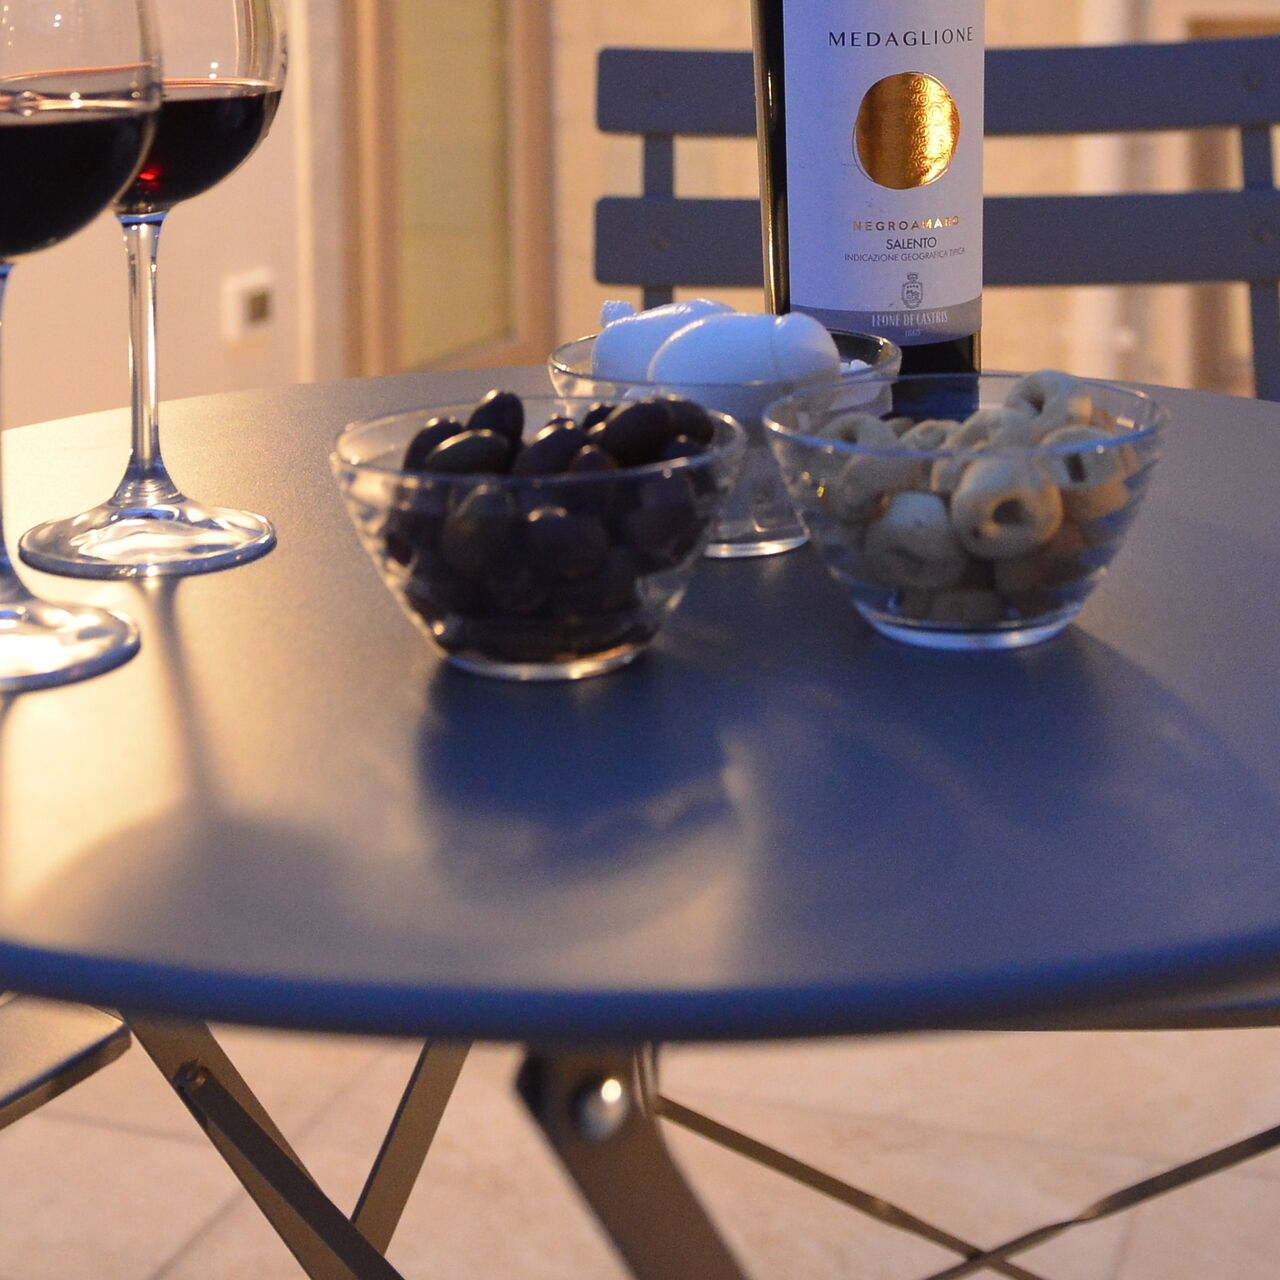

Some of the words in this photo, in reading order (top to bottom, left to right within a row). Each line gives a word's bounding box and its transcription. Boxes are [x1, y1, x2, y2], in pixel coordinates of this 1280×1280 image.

[829, 27, 972, 46] MEDAGLIONE
[853, 216, 959, 231] NEGROAMARO
[886, 237, 937, 250] SALENTO
[844, 253, 898, 262] INDICAZIONE
[901, 248, 947, 261] GEOGRAFICA
